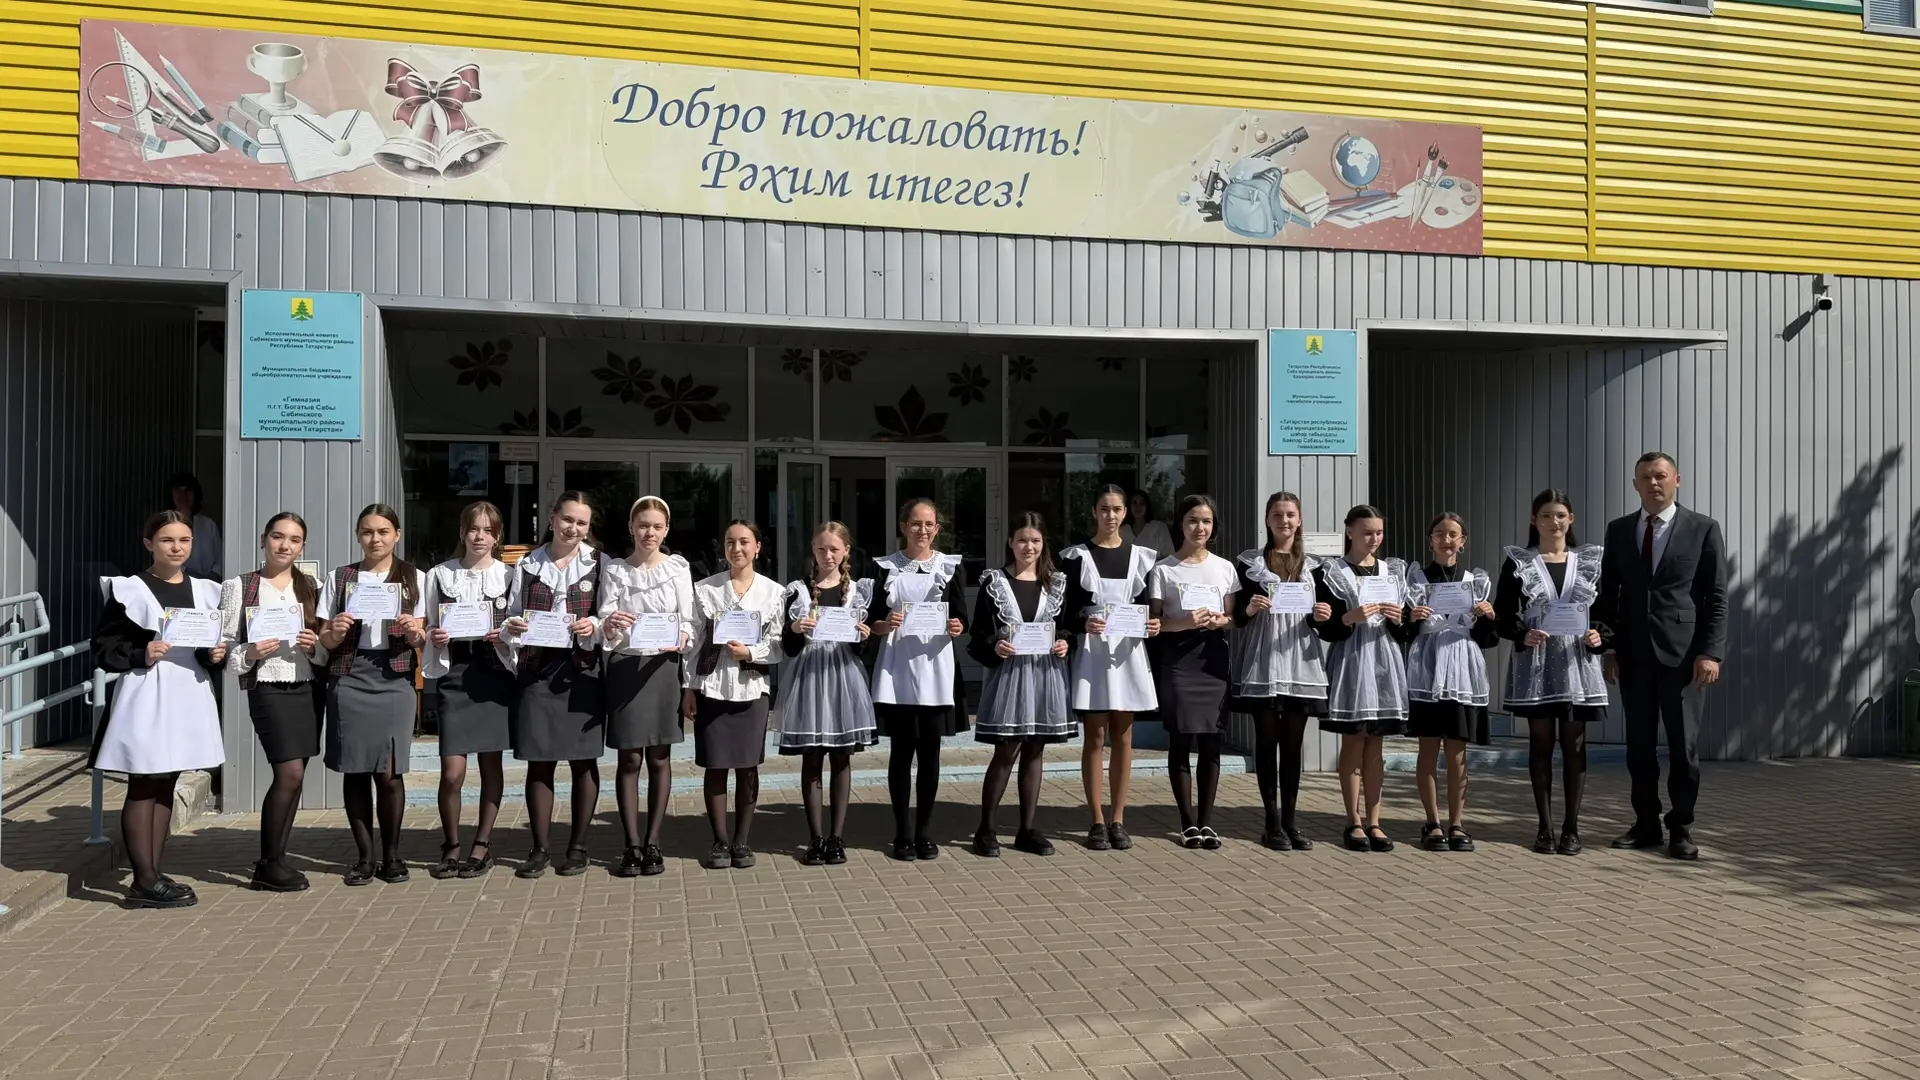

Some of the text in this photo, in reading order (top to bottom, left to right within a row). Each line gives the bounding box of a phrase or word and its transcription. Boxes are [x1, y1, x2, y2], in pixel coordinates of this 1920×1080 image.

[612, 82, 1089, 158] Добро пожаловать!
[701, 149, 1031, 209] Рәхим итегез!
